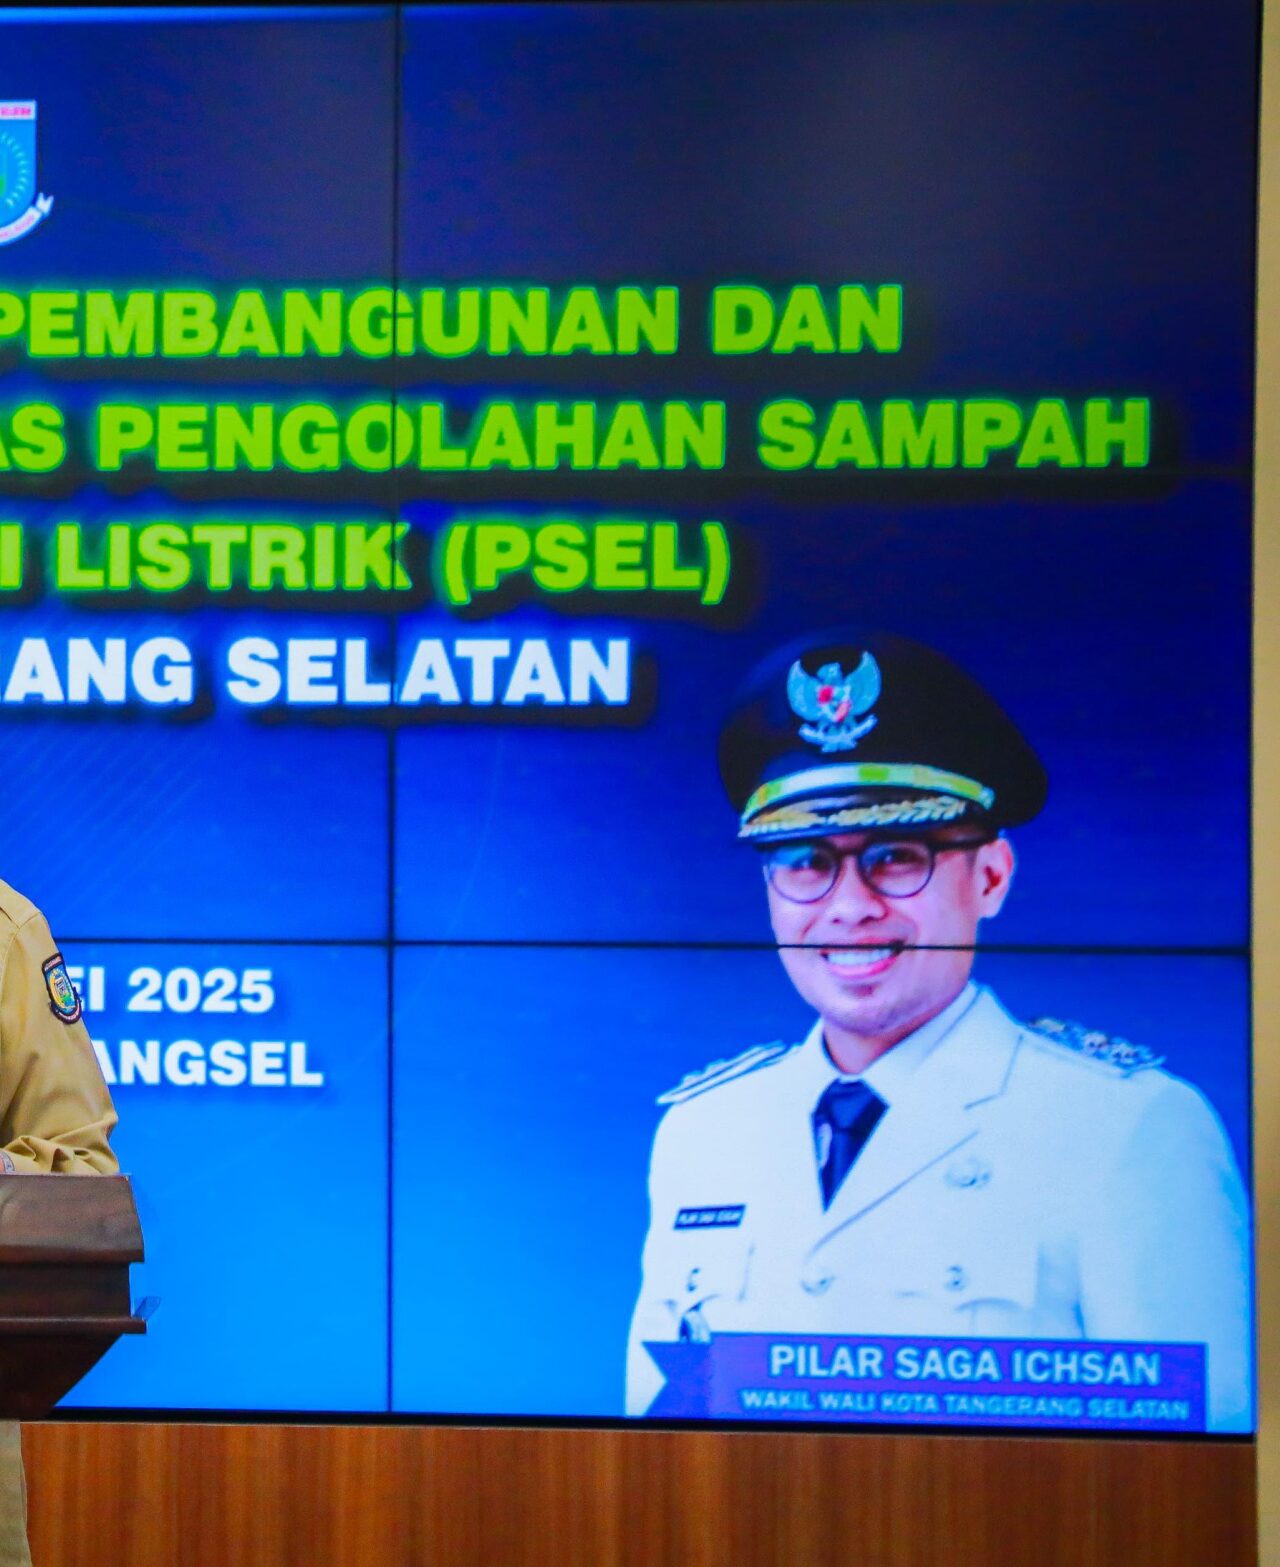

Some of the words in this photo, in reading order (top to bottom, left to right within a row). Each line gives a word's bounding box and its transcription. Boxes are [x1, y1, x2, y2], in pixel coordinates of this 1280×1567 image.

[713, 286, 901, 353] DAN
[98, 403, 724, 471] PENGOLAHAN
[760, 402, 1147, 468] SAMPAH
[56, 523, 410, 590] LISTRIK
[444, 522, 731, 604] (PSEL)
[226, 637, 630, 706] SELATAN
[127, 967, 274, 1013] 2025
[771, 1345, 883, 1377] PILAR
[896, 1348, 1000, 1380] SAGA
[1013, 1351, 1159, 1386] ICHSAN
[741, 1391, 813, 1410] WAKIL
[818, 1392, 876, 1412] WALI
[881, 1393, 939, 1413] KOTA
[944, 1395, 1082, 1417] TANGERANG
[1088, 1398, 1189, 1420] SELATAN
